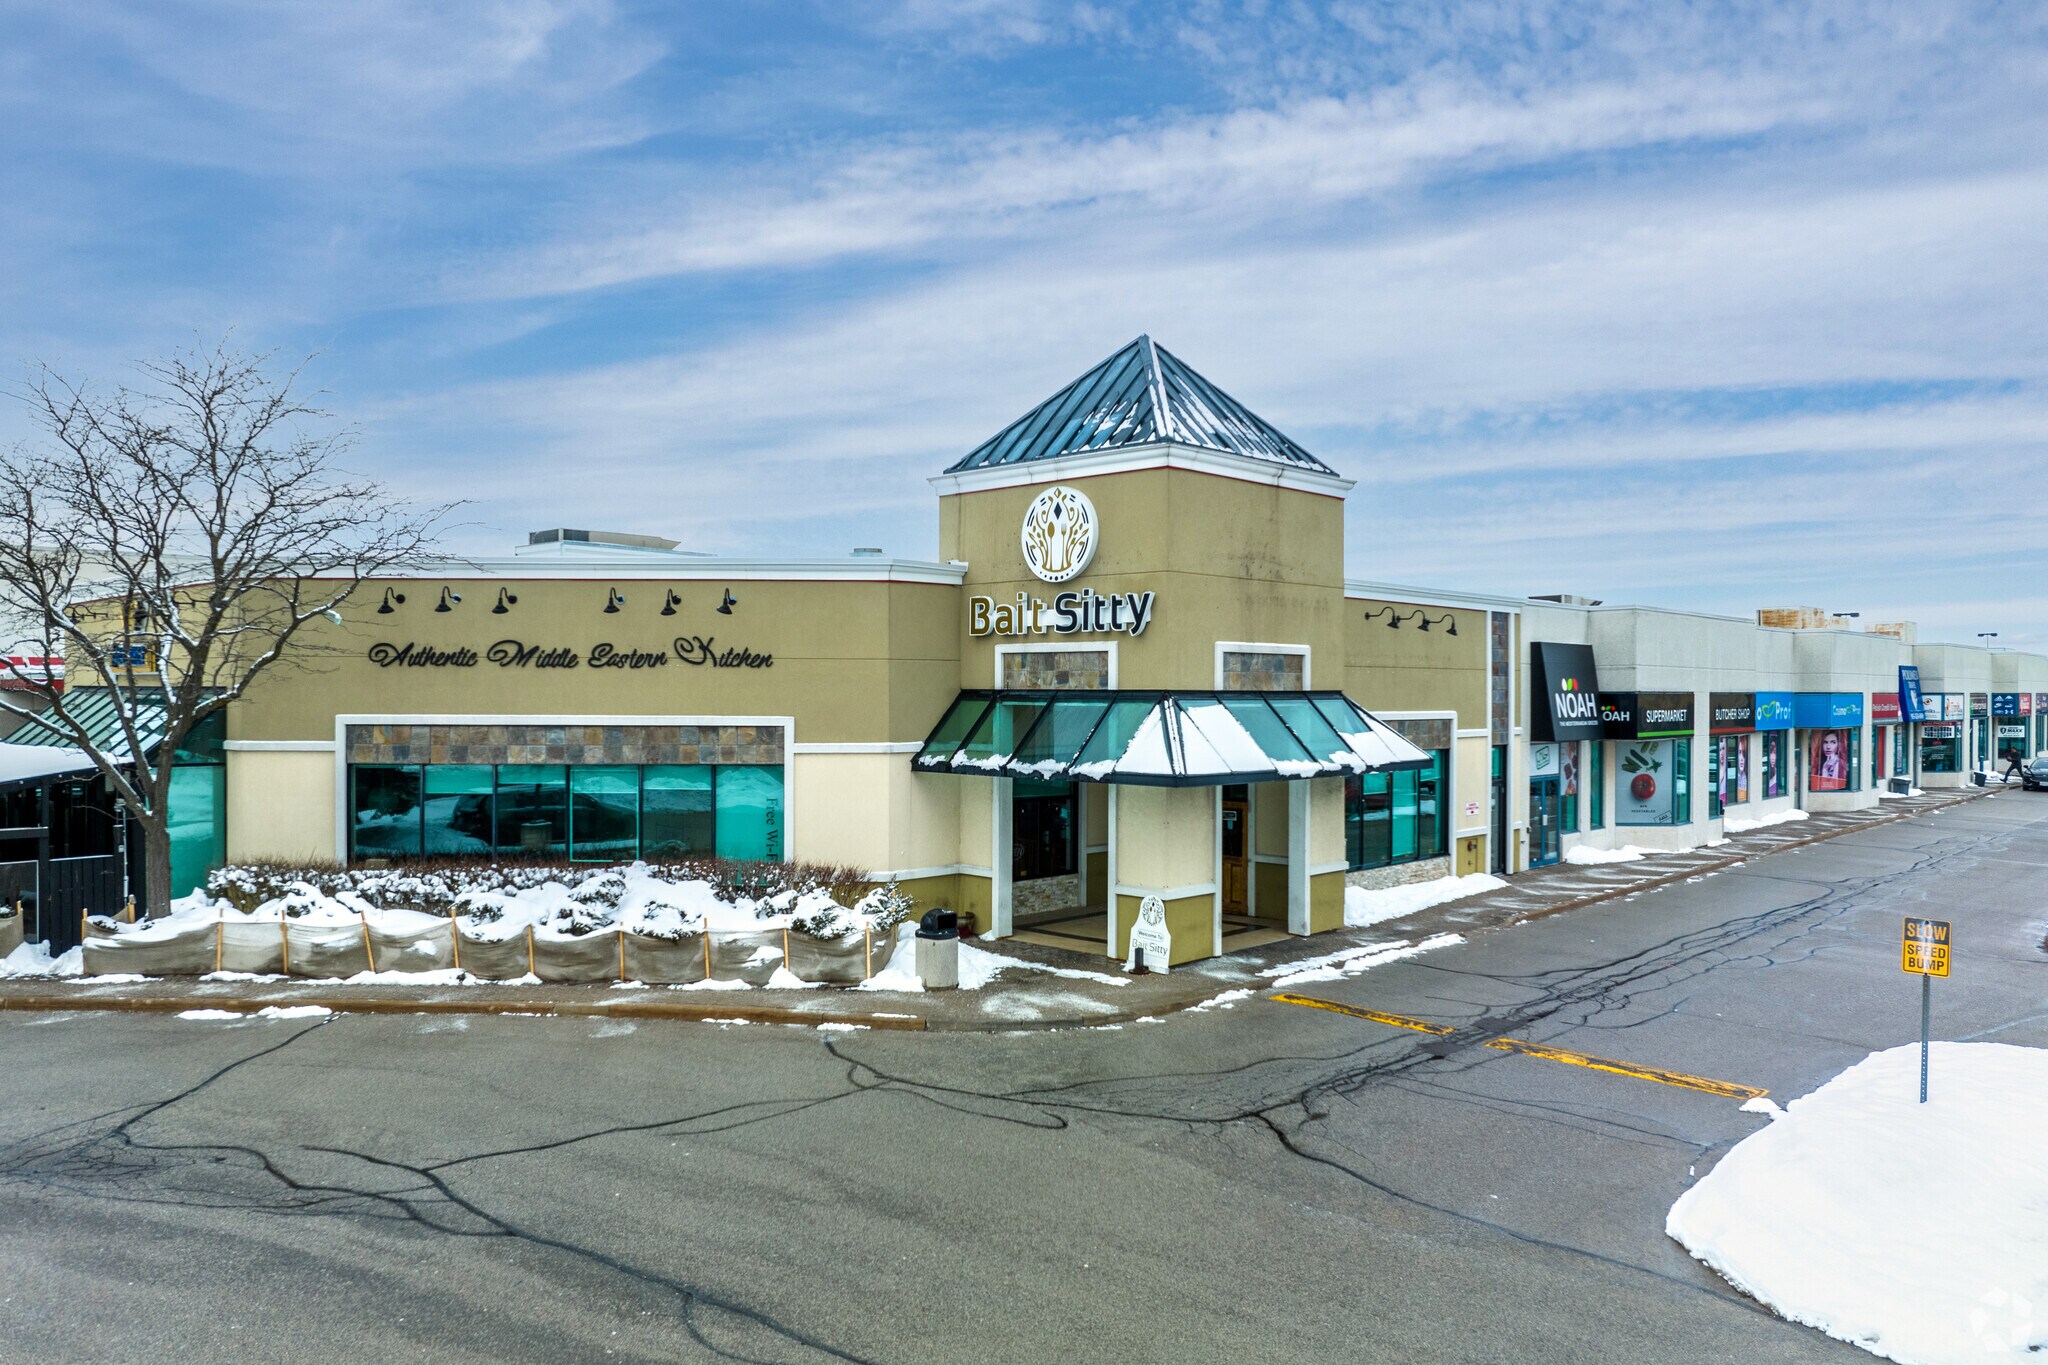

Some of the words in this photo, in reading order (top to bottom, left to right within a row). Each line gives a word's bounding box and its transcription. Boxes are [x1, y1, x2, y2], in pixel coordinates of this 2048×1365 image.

[969, 591, 1047, 637] Bait
[1054, 588, 1155, 637] Sitty
[368, 642, 478, 667] Authentic
[487, 639, 579, 668] Middle
[588, 642, 668, 668] Eastern
[674, 636, 774, 668] Kitchen
[1555, 693, 1597, 718] NOAH
[1602, 711, 1630, 721] OAH
[1646, 709, 1687, 723] SUPERMARKET
[1715, 708, 1737, 720] BUTCHER
[1738, 708, 1750, 719] SHOP
[766, 798, 779, 826] Free
[766, 829, 779, 862] Wi-F
[1907, 922, 1947, 940] SLOW
[1149, 942, 1168, 956] Sitty
[1907, 944, 1946, 959] SPEED
[1908, 957, 1944, 970] BUMP
